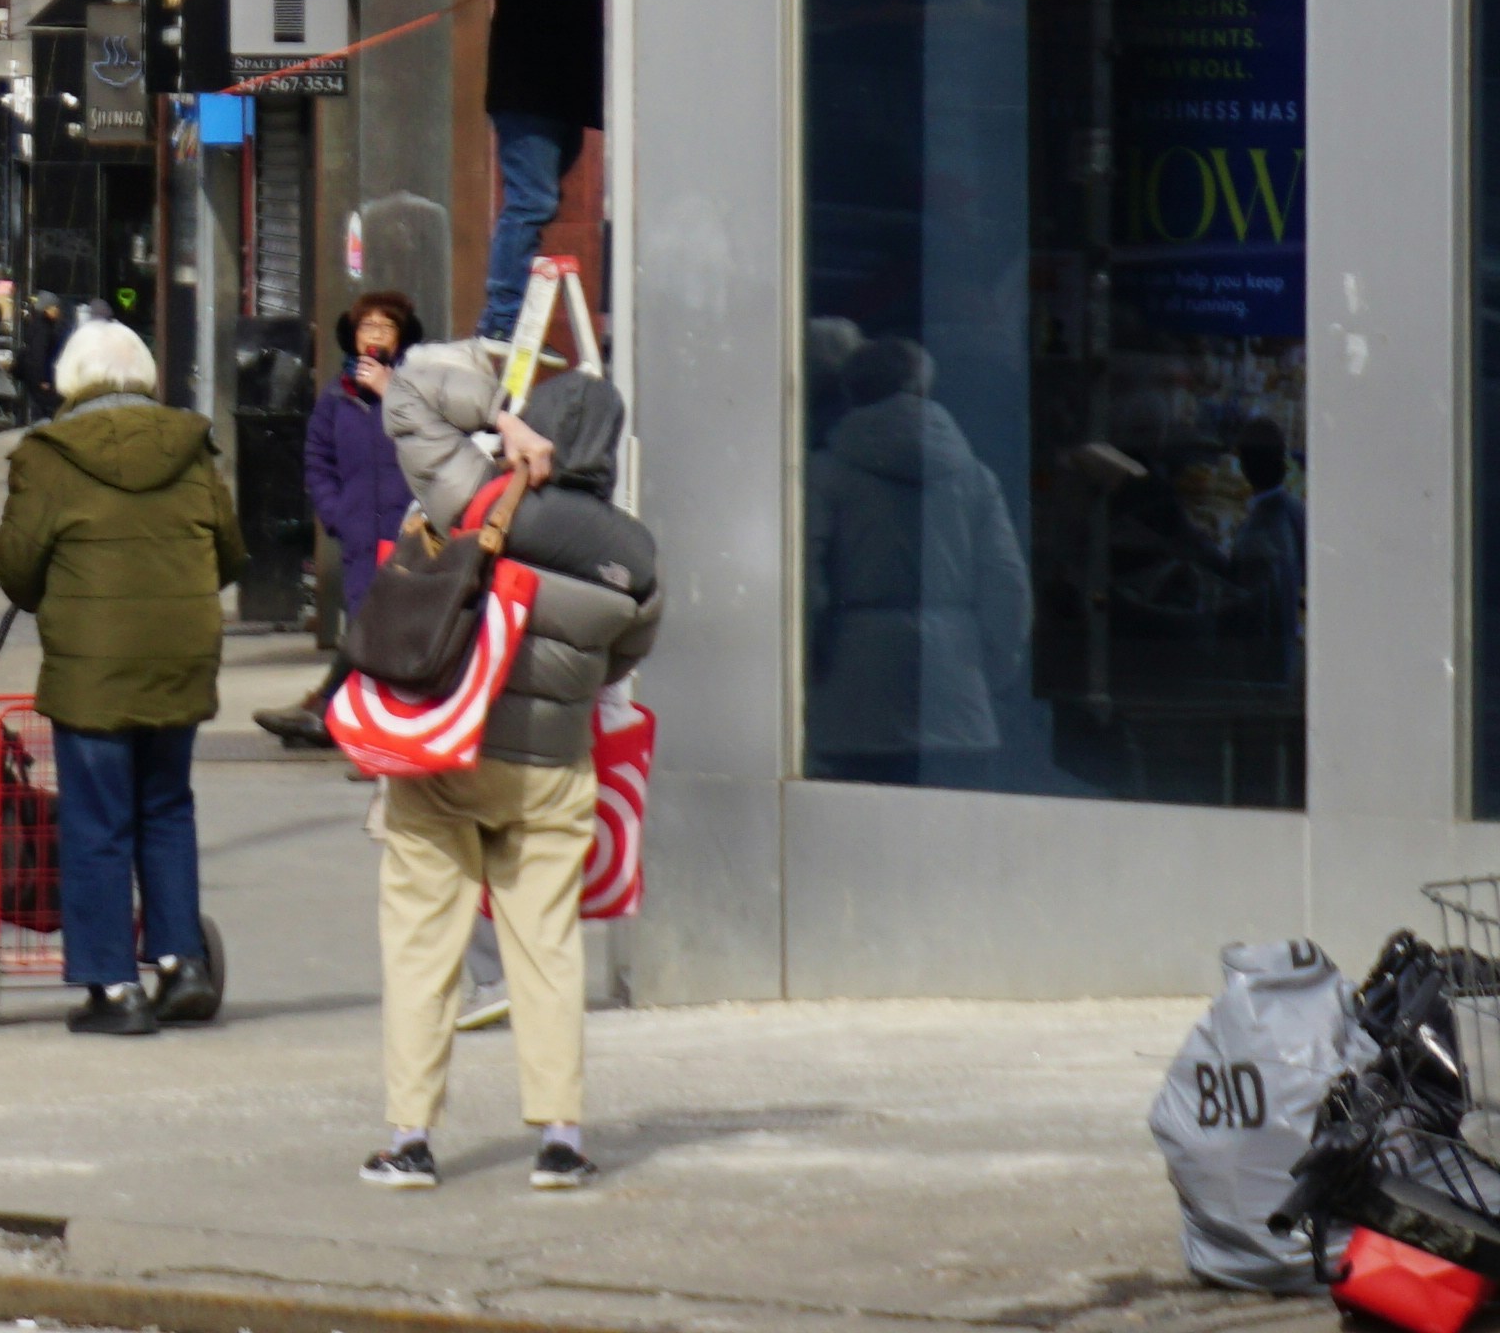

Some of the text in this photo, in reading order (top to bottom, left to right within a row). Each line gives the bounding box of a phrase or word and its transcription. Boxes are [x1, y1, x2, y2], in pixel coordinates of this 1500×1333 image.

[235, 57, 277, 69] SPACE
[1148, 57, 1254, 81] AYROLL.
[1132, 99, 1299, 122] USINESS HAS
[1214, 275, 1243, 294] you
[1245, 272, 1286, 294] keep
[1196, 1061, 1266, 1129] BID
